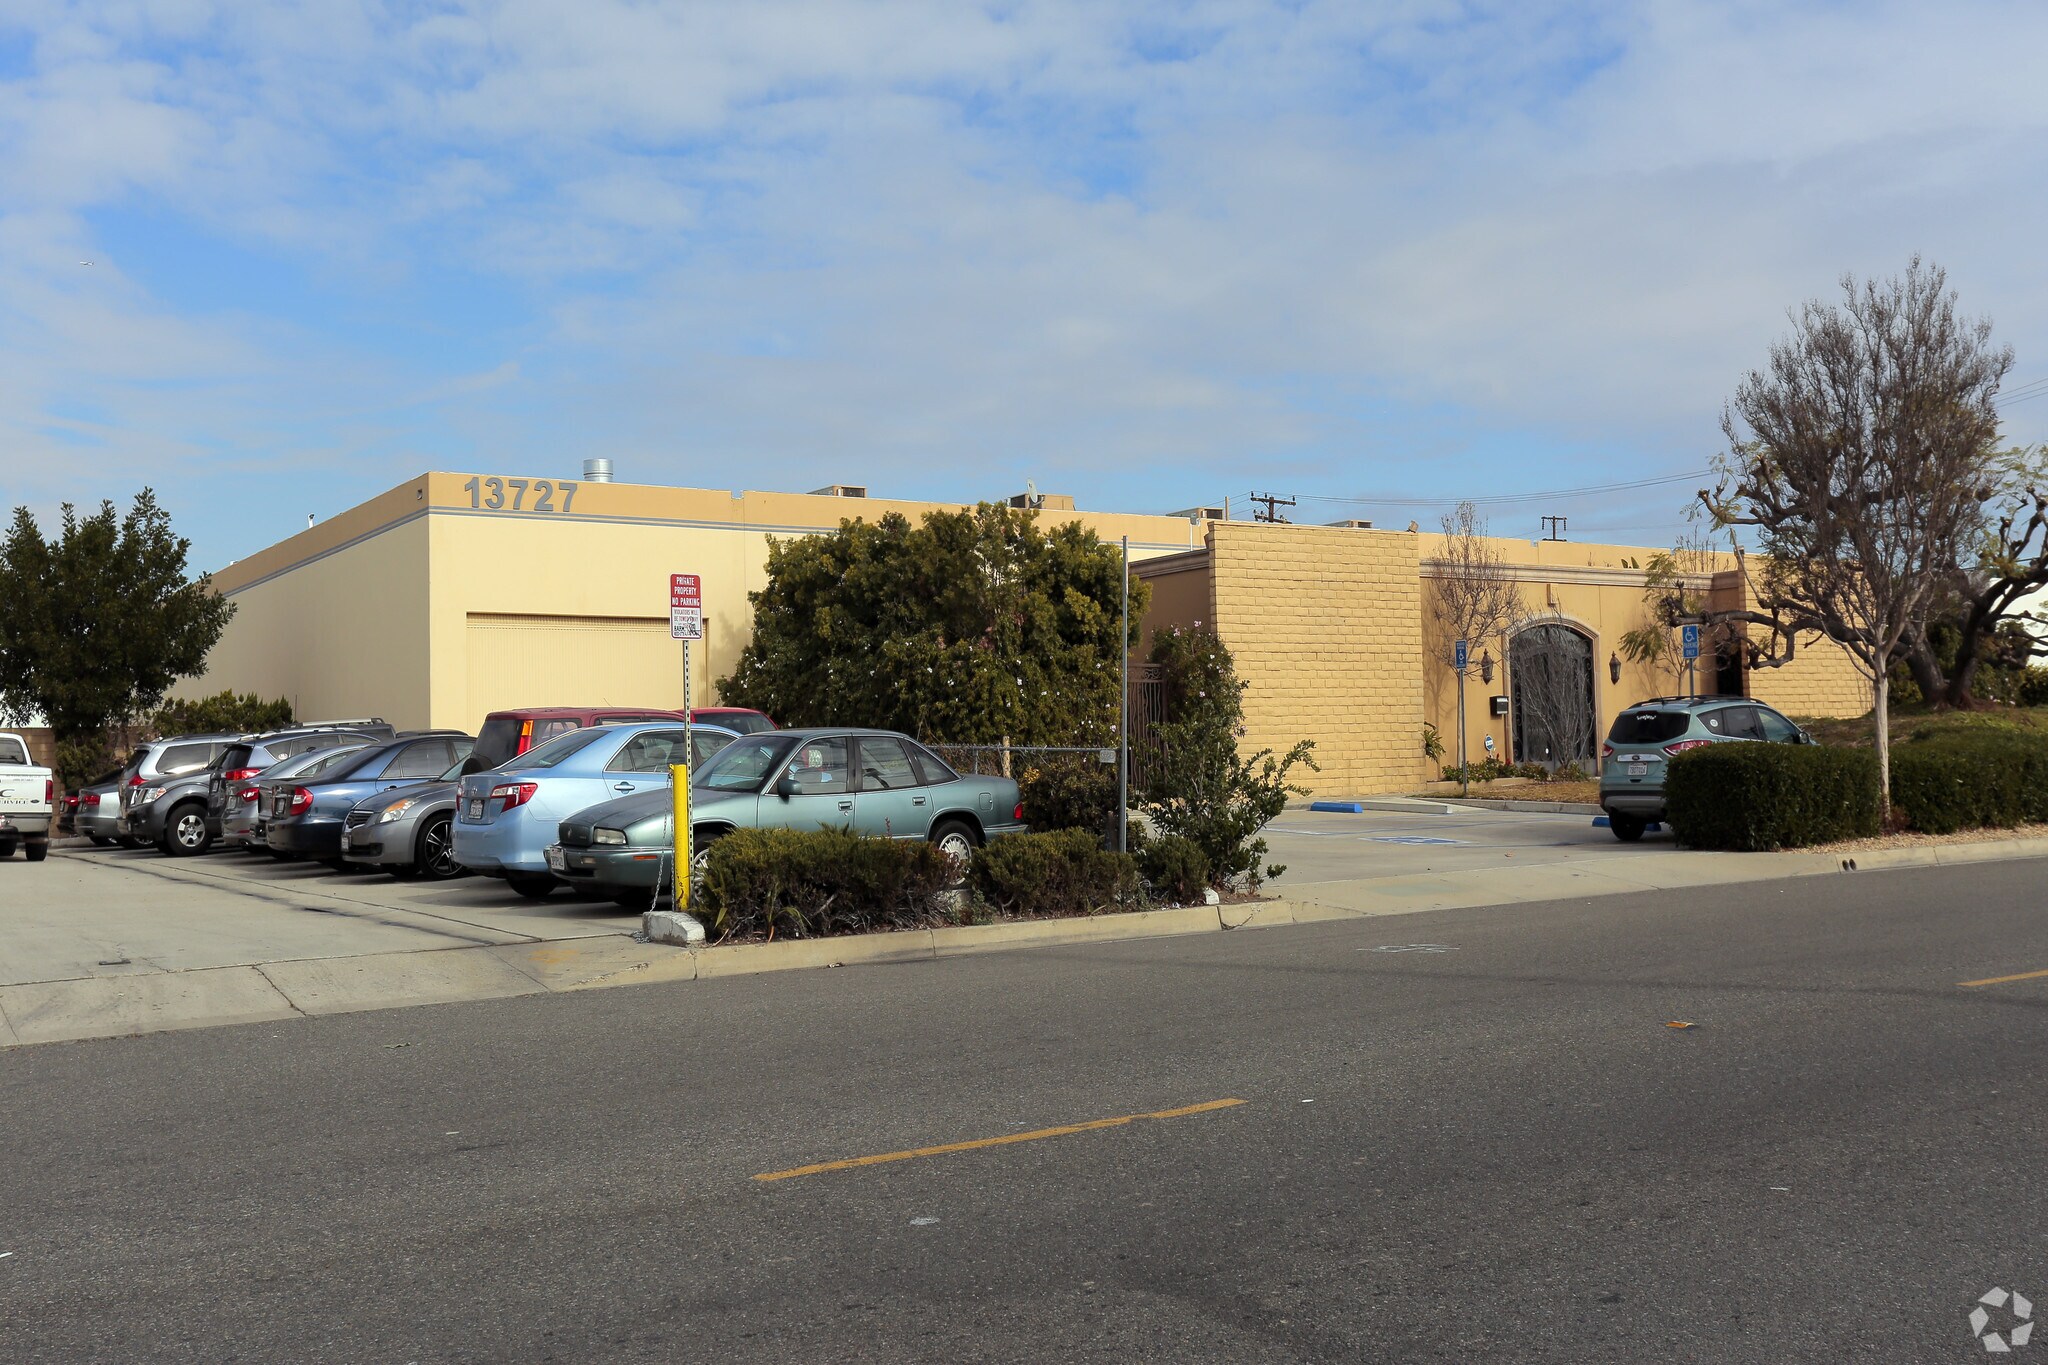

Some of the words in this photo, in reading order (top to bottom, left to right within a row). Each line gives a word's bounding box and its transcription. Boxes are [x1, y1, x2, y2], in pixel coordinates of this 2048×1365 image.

[464, 476, 578, 512] 13727
[676, 577, 695, 586] PRIVATE
[674, 587, 697, 596] PROPERTY
[672, 597, 679, 606] NO
[680, 597, 700, 607] PARKING
